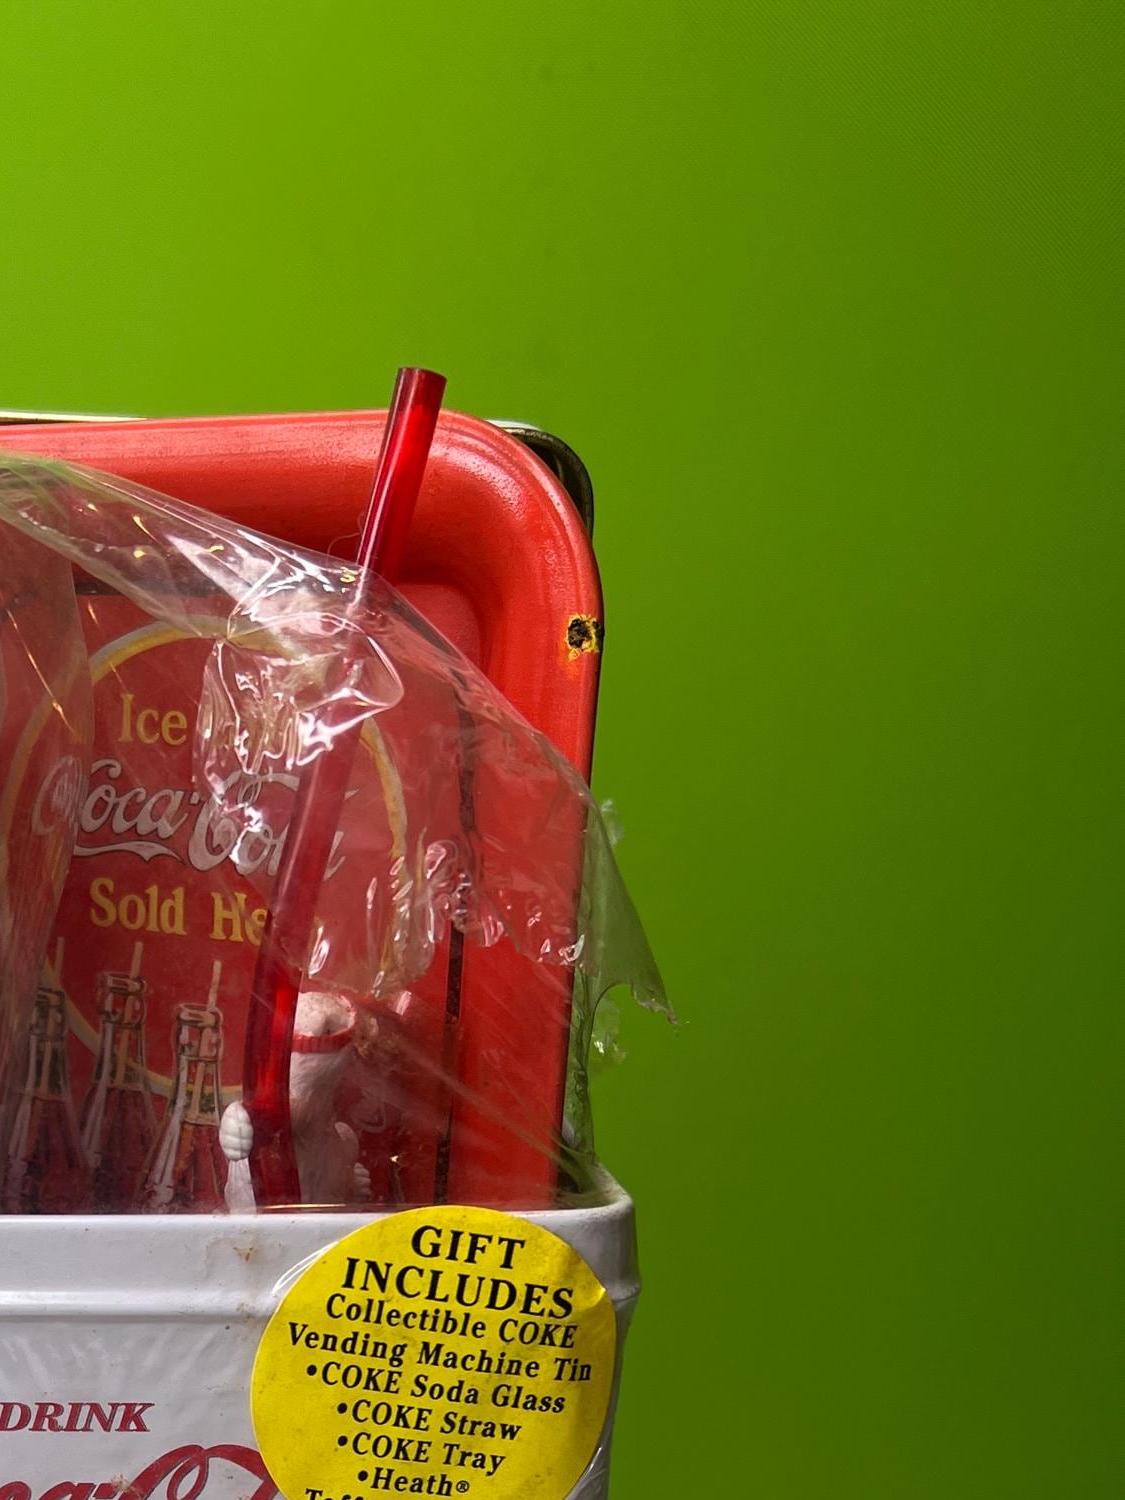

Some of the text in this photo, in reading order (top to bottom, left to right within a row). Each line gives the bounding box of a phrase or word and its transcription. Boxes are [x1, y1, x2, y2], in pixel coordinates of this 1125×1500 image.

[118, 693, 187, 745] Ice
[90, 877, 268, 946] Sold He
[411, 1225, 525, 1270] GIFT
[342, 1257, 574, 1319] INCLUDES
[326, 1293, 578, 1349] Collectible COKE
[287, 1322, 591, 1381] Vending Machine Tin
[410, 1374, 479, 1405] Soda
[491, 1384, 566, 1413] Glass
[440, 1412, 522, 1441] Straw
[443, 1444, 506, 1477] Tray
